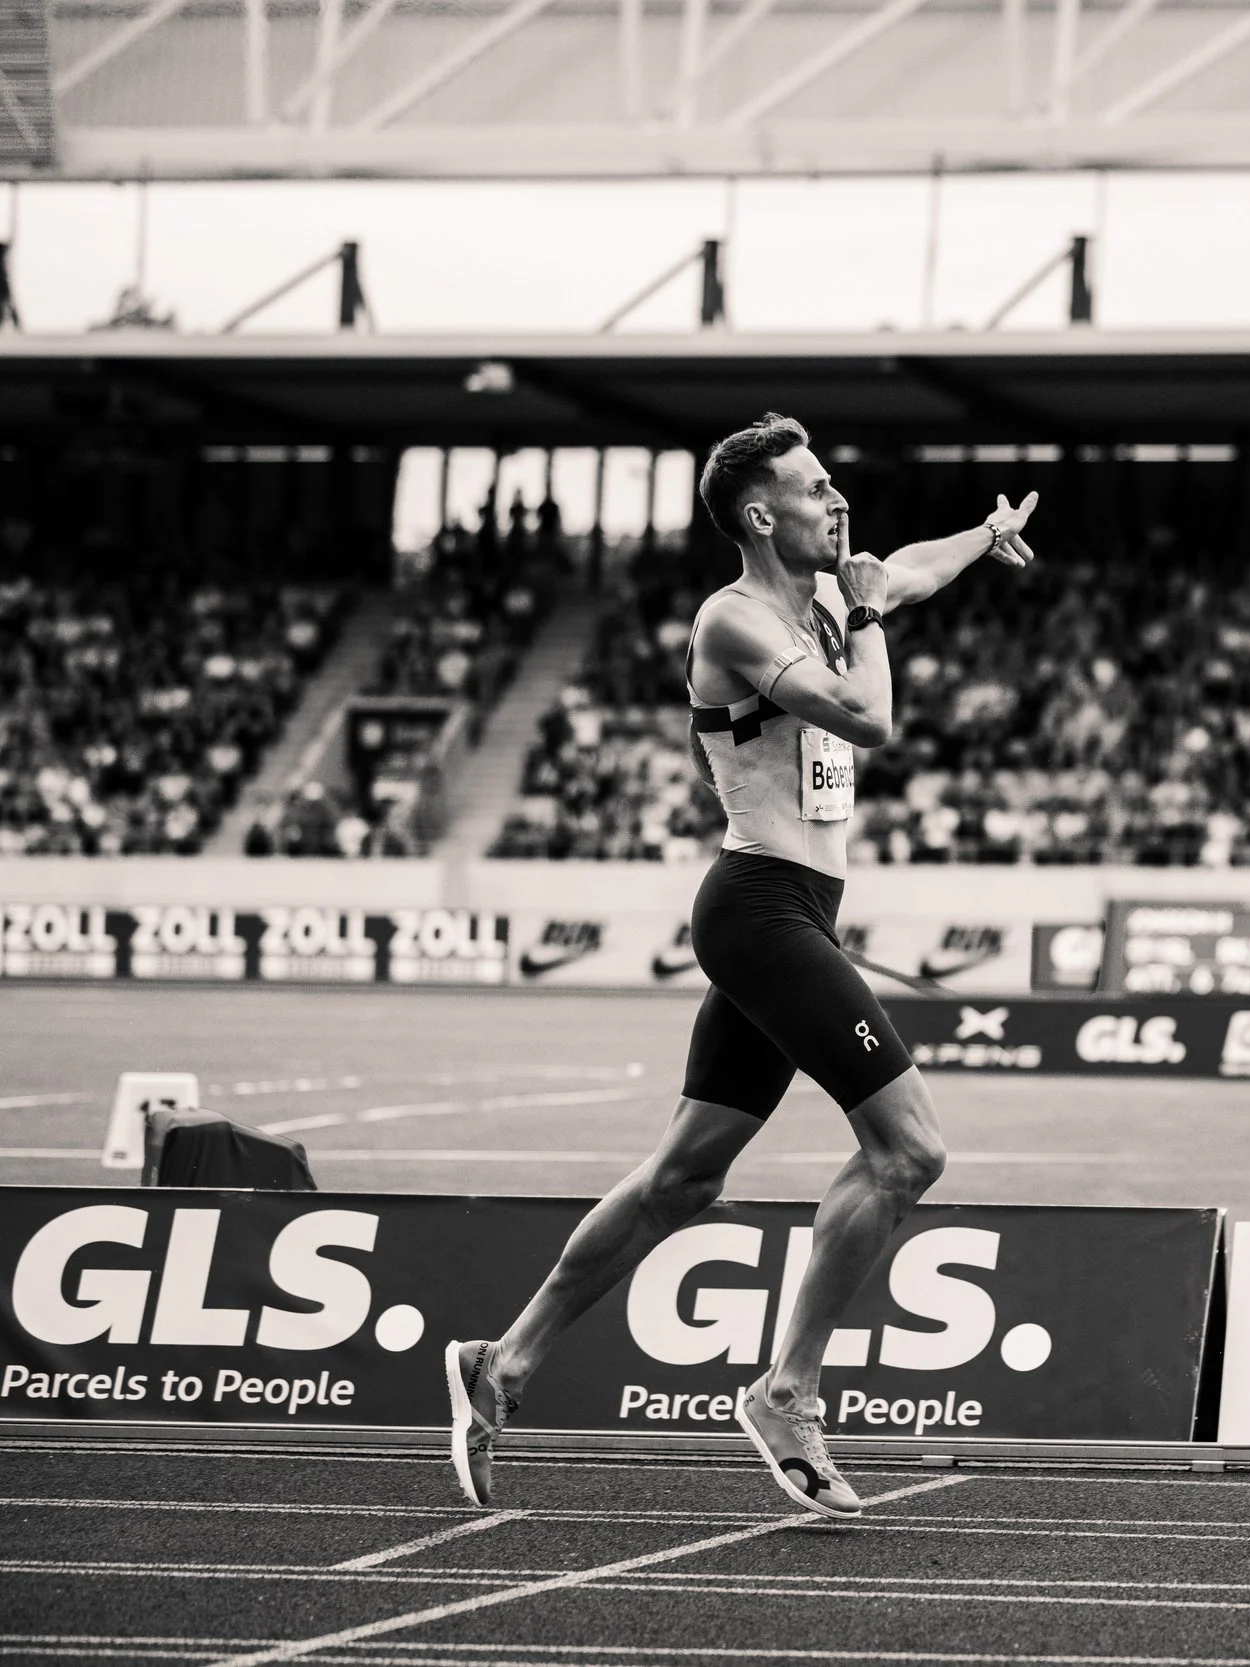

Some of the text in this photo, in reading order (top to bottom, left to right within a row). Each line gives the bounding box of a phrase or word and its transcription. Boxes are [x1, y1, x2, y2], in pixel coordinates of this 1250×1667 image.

[3, 904, 117, 953] ZOLL
[131, 904, 246, 955] ZOLL
[259, 906, 377, 957] ZOLL
[388, 908, 506, 959] ZOLL
[1076, 1015, 1187, 1064] GLS.
[13, 1204, 425, 1351] GLS.
[2, 1365, 355, 1415] Parcels to People
[466, 1357, 485, 1402] RUNNIN
[619, 1385, 747, 1421] Parcel
[838, 1389, 983, 1436] People
